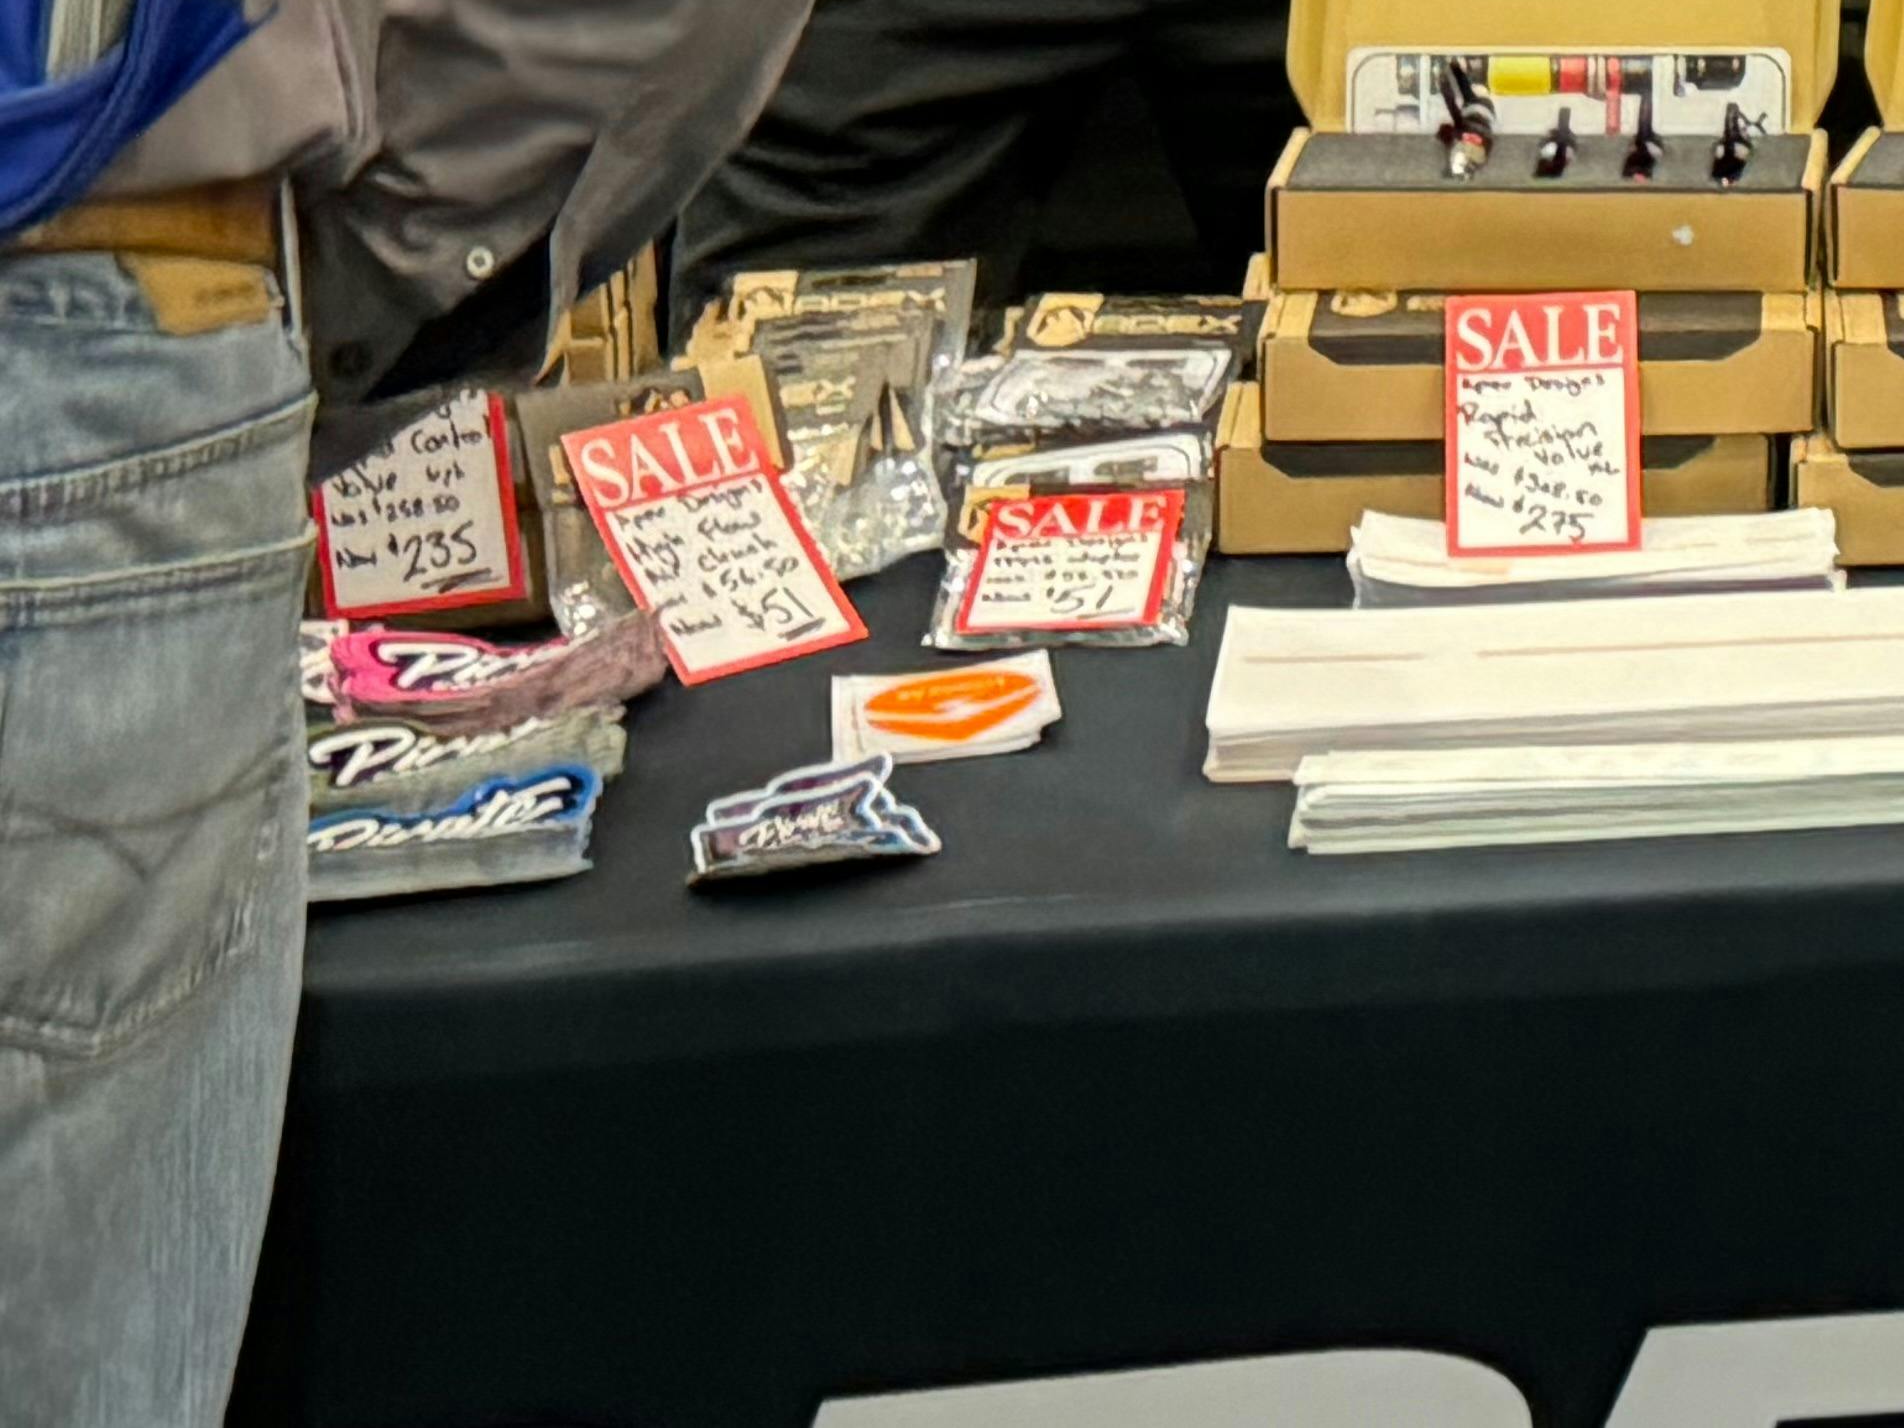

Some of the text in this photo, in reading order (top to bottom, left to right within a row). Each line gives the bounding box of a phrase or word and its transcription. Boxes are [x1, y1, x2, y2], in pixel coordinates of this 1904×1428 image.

[1455, 303, 1625, 371] SALE
[579, 407, 760, 508] SALE
[991, 494, 1168, 539] SALE
